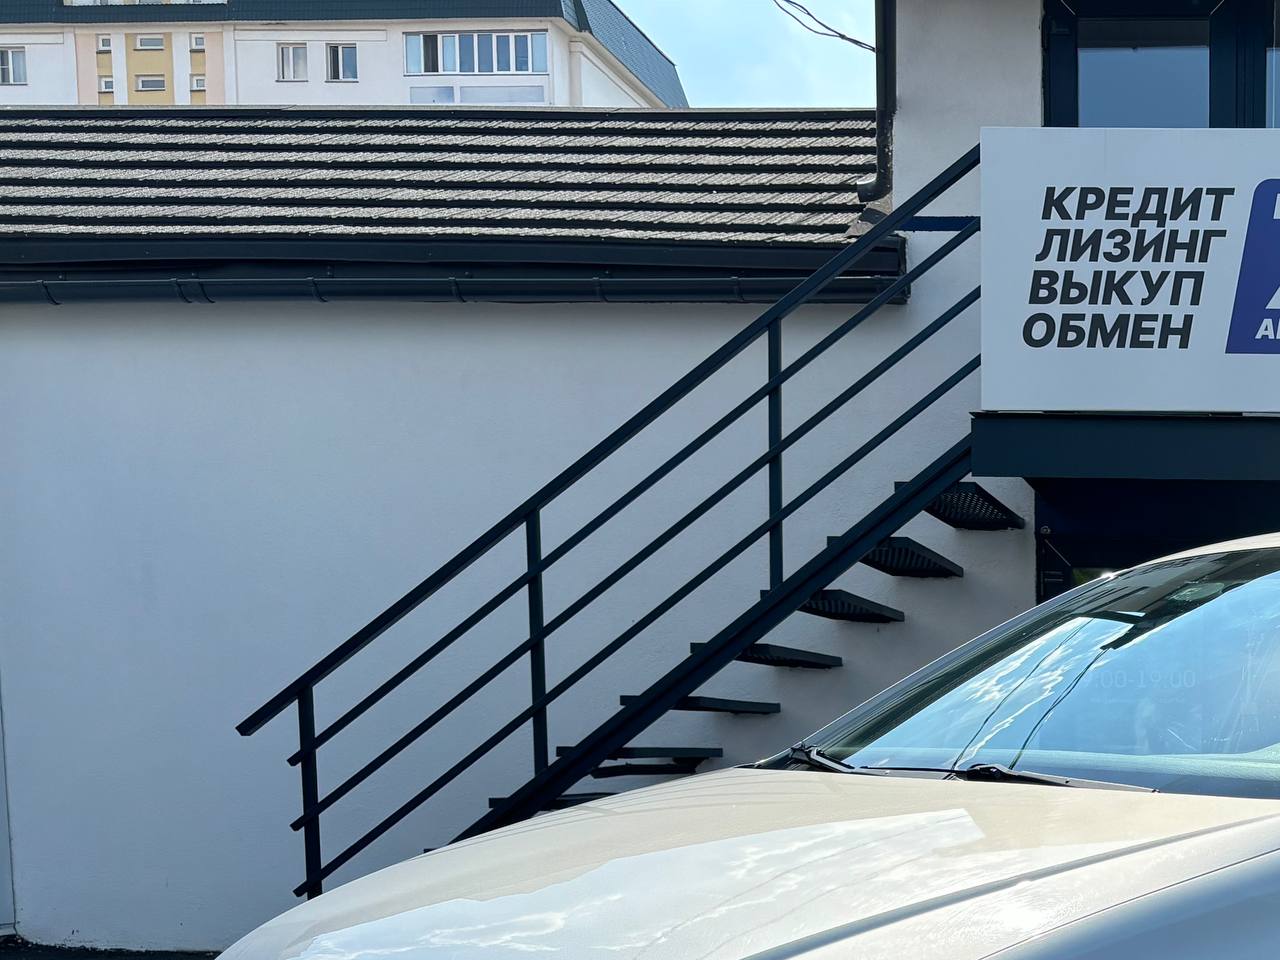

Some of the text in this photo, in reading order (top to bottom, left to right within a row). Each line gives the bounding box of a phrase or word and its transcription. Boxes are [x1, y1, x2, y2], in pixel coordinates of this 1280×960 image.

[1041, 186, 1235, 228] КРЕДИТ
[1035, 228, 1227, 263] ЛИЗИНГ
[1028, 269, 1205, 306] ВЫКУП
[1022, 312, 1194, 349] ОБМЕН
